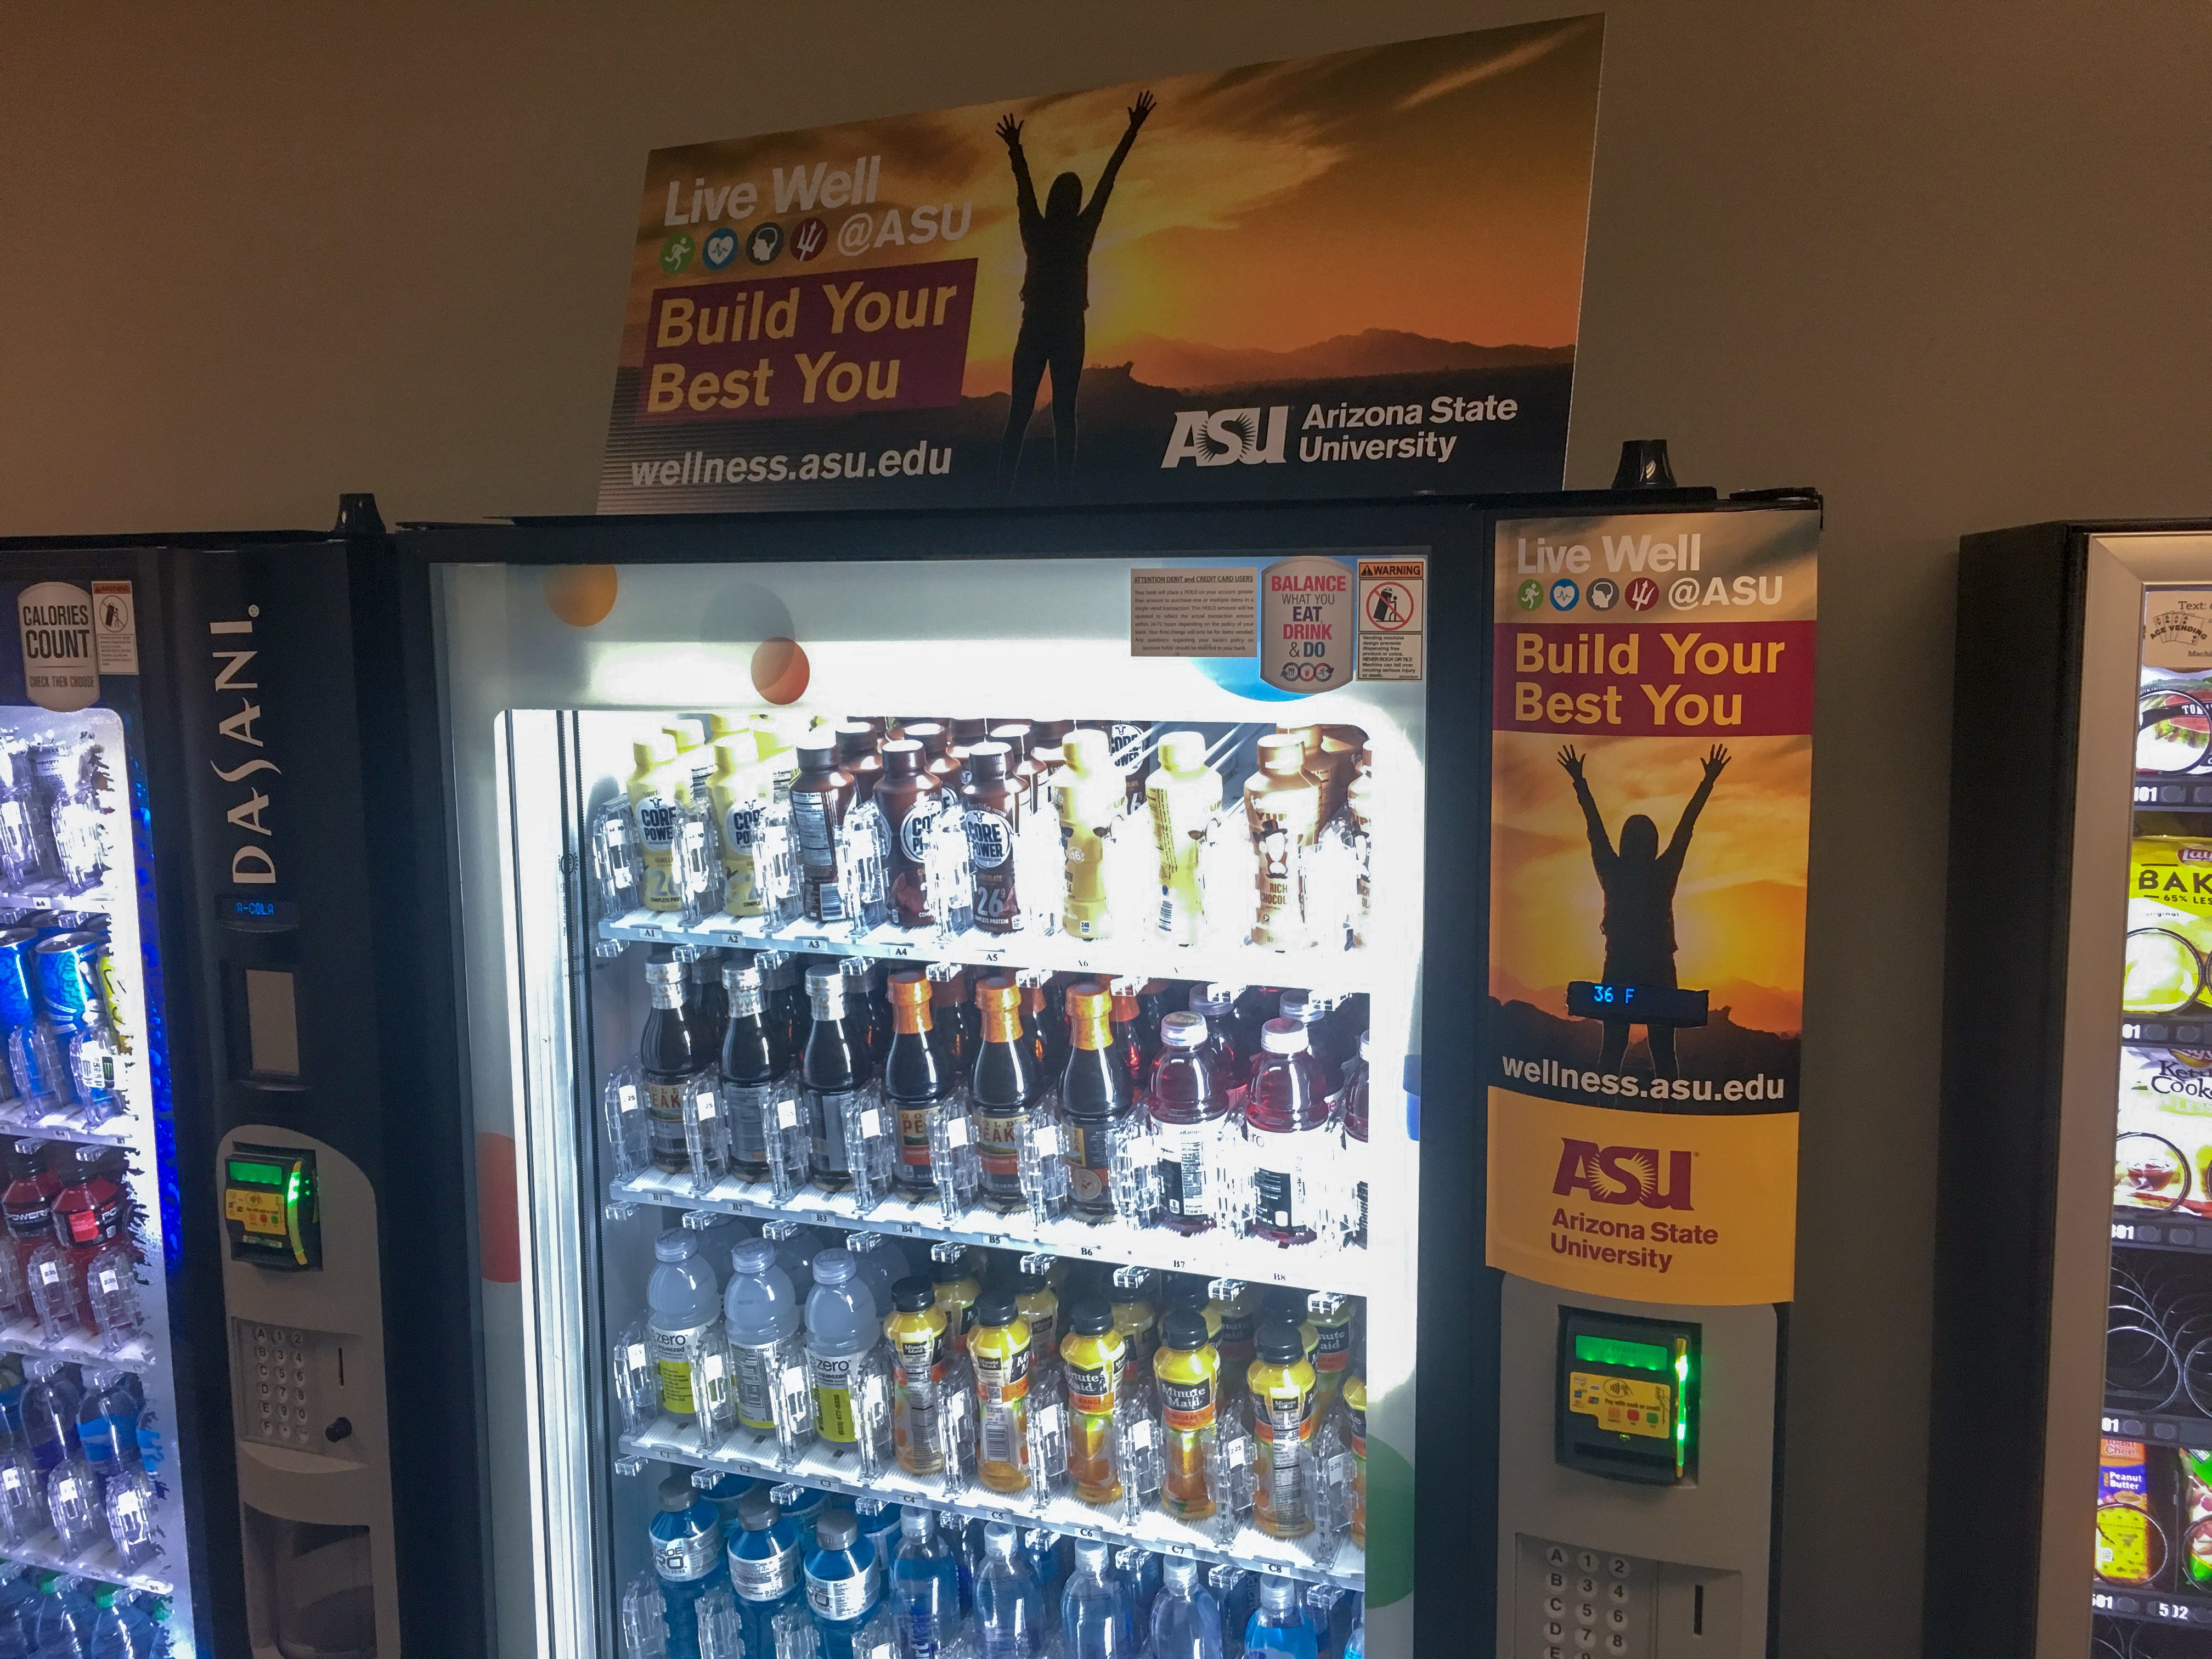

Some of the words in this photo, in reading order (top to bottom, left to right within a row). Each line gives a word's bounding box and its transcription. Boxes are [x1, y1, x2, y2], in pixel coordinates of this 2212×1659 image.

[664, 177, 758, 227] Live
[772, 155, 881, 214] Well
[836, 201, 972, 257] @ASU
[656, 287, 800, 348] Build
[822, 281, 958, 335] Your
[646, 358, 774, 413] Best
[794, 351, 901, 404] You
[1301, 402, 1423, 430] Arizona
[1428, 394, 1518, 424] State
[1160, 405, 1289, 469] ASU
[1299, 431, 1458, 463] University
[631, 440, 952, 487] wellness.asu.edu
[1517, 537, 1590, 574] Live
[1601, 533, 1701, 573] Well
[1373, 565, 1421, 575] WARNING
[1271, 575, 1346, 592] BALANCE
[1282, 594, 1311, 605] WHAT
[1314, 594, 1335, 605] YOU
[1668, 575, 1783, 611] @ASU
[2177, 601, 2207, 610] Text:
[22, 605, 89, 626] CALORIES
[1293, 606, 1323, 623] EAT,
[1283, 624, 1333, 640] DRINK
[2149, 627, 2167, 640] ACE
[2168, 624, 2208, 640] VENDING
[25, 629, 90, 659] COUNT
[1289, 641, 1300, 658] &
[1304, 641, 1325, 658] DO
[1515, 633, 1639, 675] Build
[1660, 633, 1786, 675] Your
[30, 675, 49, 687] CHECK
[52, 675, 67, 687] THEN
[70, 675, 94, 687] CHOOSE
[1515, 682, 1622, 724] Best
[1639, 684, 1743, 726] You
[209, 620, 282, 884] DASANI
[967, 821, 1002, 843] CORE
[1269, 882, 1288, 893] RICH
[2163, 894, 2188, 902] 65%
[644, 929, 656, 937] A1
[727, 934, 739, 943] A2
[808, 940, 820, 948] A3
[895, 947, 907, 956] A4
[986, 953, 998, 962] A5
[1593, 985, 1614, 1003] 36
[1624, 988, 1635, 1004] F
[1502, 1055, 1785, 1101] wellness.asu.edu
[1551, 1137, 1695, 1211] ASU
[732, 1204, 744, 1212] B2
[816, 1214, 827, 1222] B3
[901, 1224, 913, 1233] B4
[1551, 1207, 1646, 1240] Arizona
[1650, 1221, 1719, 1245] State
[989, 1235, 1001, 1244] B5
[1081, 1247, 1093, 1256] B6
[1550, 1232, 1673, 1273] University
[1173, 1260, 1185, 1268] B7
[655, 1333, 686, 1346] zero
[816, 1358, 849, 1372] zero
[1161, 1383, 1206, 1398] Minute
[1167, 1396, 1200, 1409] Maid
[659, 1450, 671, 1458] C1
[740, 1465, 751, 1473] C2
[2109, 1471, 2142, 1482] Peanut
[820, 1479, 832, 1488] C3
[2109, 1480, 2140, 1491] Butter
[903, 1495, 915, 1504] C4
[991, 1511, 1004, 1521] C5
[1080, 1528, 1093, 1538] C6
[1171, 1545, 1185, 1555] C7
[1551, 1548, 1562, 1562] A
[1584, 1555, 1590, 1567] 1
[1614, 1559, 1624, 1573] 2
[1268, 1564, 1282, 1573] C8
[1551, 1573, 1562, 1587] B
[1583, 1579, 1592, 1592] 3
[1614, 1585, 1623, 1598] 4
[1550, 1597, 1562, 1611] C
[1582, 1604, 1592, 1617] 5
[1613, 1609, 1623, 1623] 6
[1550, 1622, 1561, 1635] D
[1582, 1628, 1592, 1641] 7
[1612, 1634, 1622, 1647] 8
